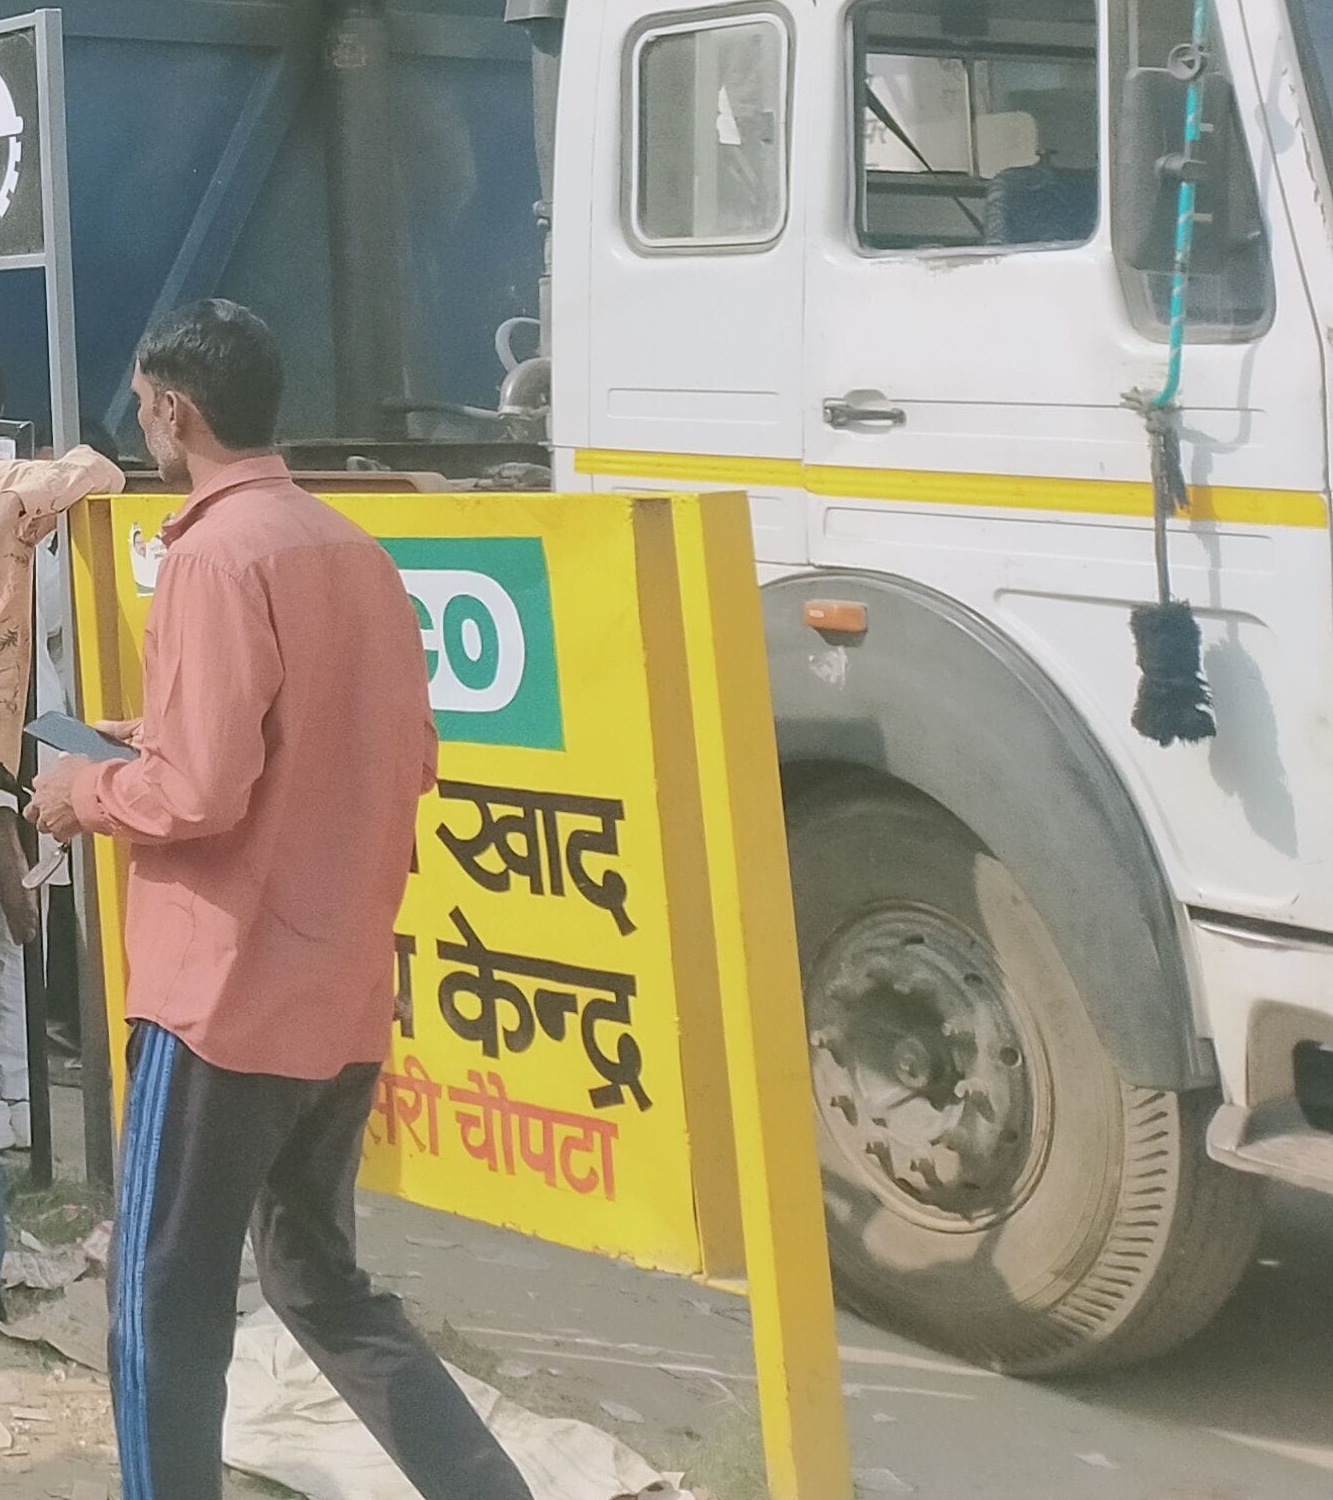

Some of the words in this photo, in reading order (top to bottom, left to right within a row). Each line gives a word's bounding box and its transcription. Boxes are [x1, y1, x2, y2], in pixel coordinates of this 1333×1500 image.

[435, 778, 638, 937] खाद
[436, 905, 653, 1112] केन्द्र
[447, 1068, 619, 1202] चौपटा
